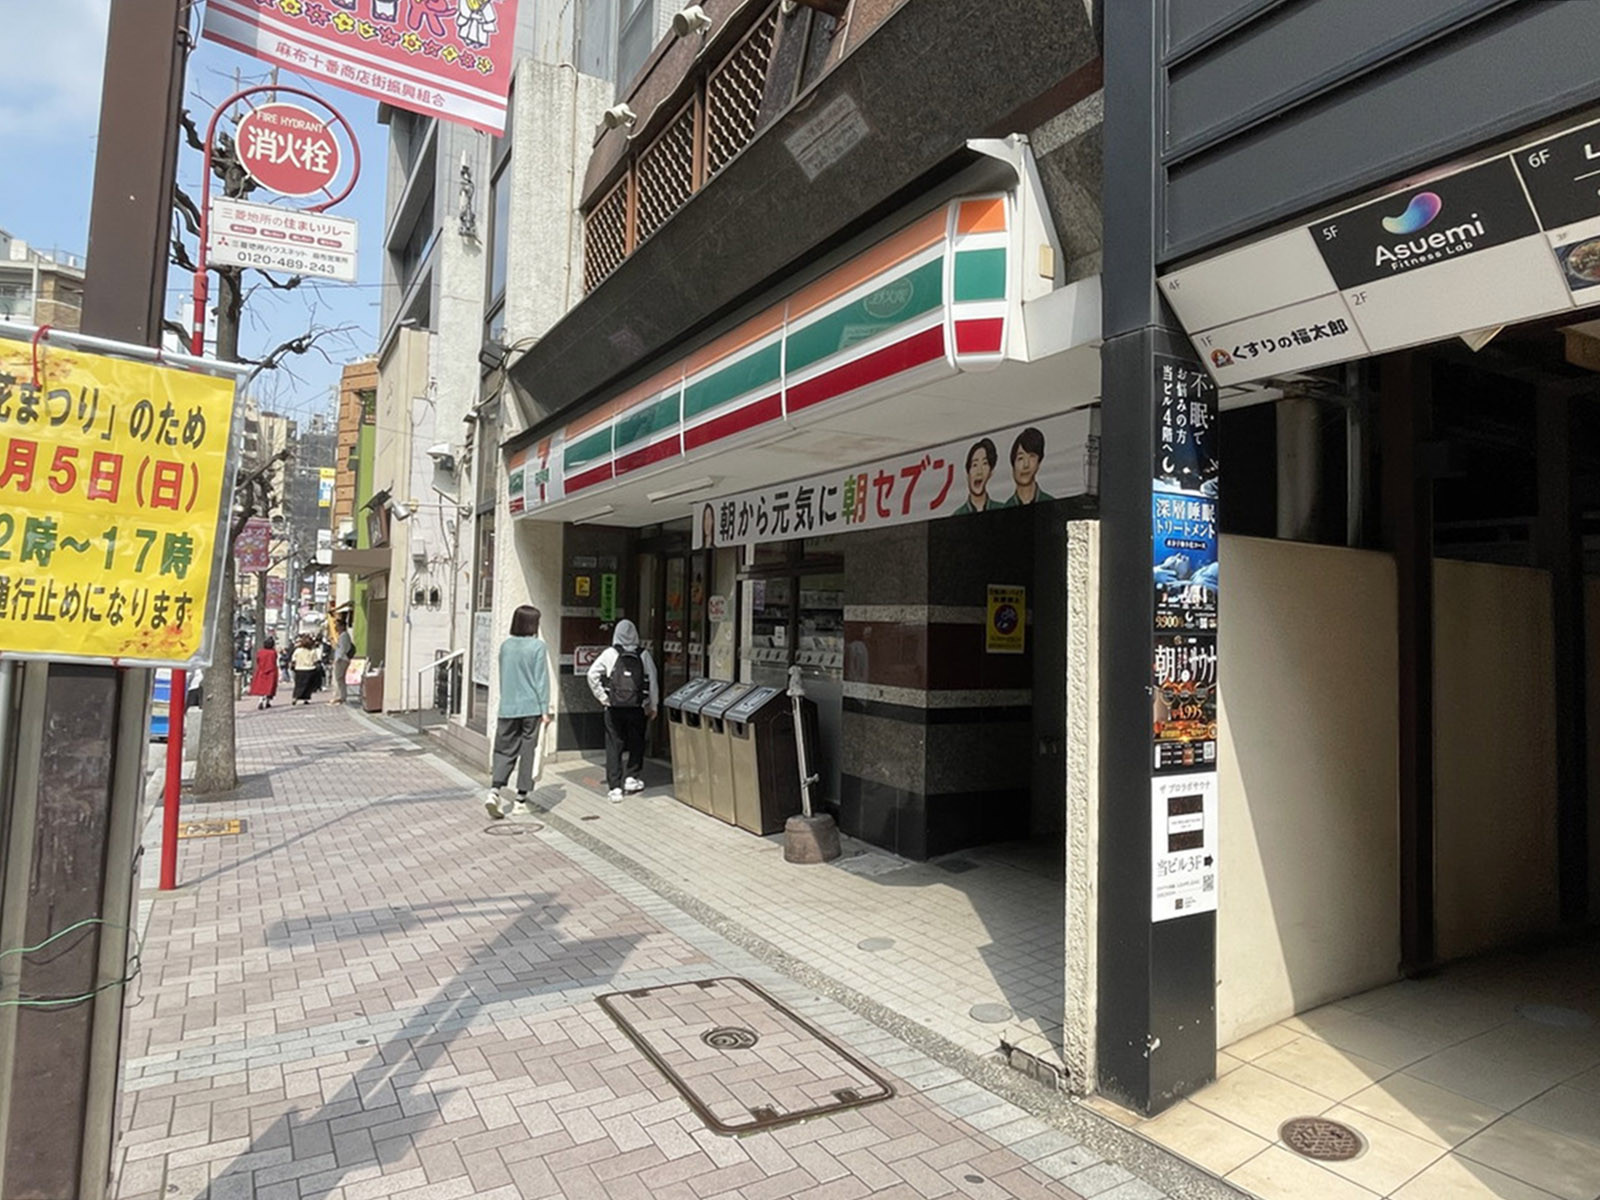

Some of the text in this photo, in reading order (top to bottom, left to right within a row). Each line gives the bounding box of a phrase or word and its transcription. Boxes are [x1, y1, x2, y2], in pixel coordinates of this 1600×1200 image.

[275, 41, 447, 108] 麻布十番商店街振興組合
[256, 110, 324, 134] FIRE HYDRANT
[247, 125, 332, 174] 消火栓
[1528, 148, 1550, 168] 6F
[222, 207, 351, 236] 三菱地所の住まいリレー
[1322, 224, 1339, 241] 5F
[1375, 212, 1485, 267] Asuemi
[237, 251, 336, 275] 0120-489-243
[1391, 240, 1474, 271] Fitness Lab
[1168, 280, 1181, 292] 4F
[1352, 291, 1368, 306] 2F
[1200, 335, 1214, 347] 1F
[1232, 318, 1349, 360] くすりの福太郎
[719, 454, 955, 542] 朝から元気に朝セブン
[1156, 519, 1216, 540] トリートメント
